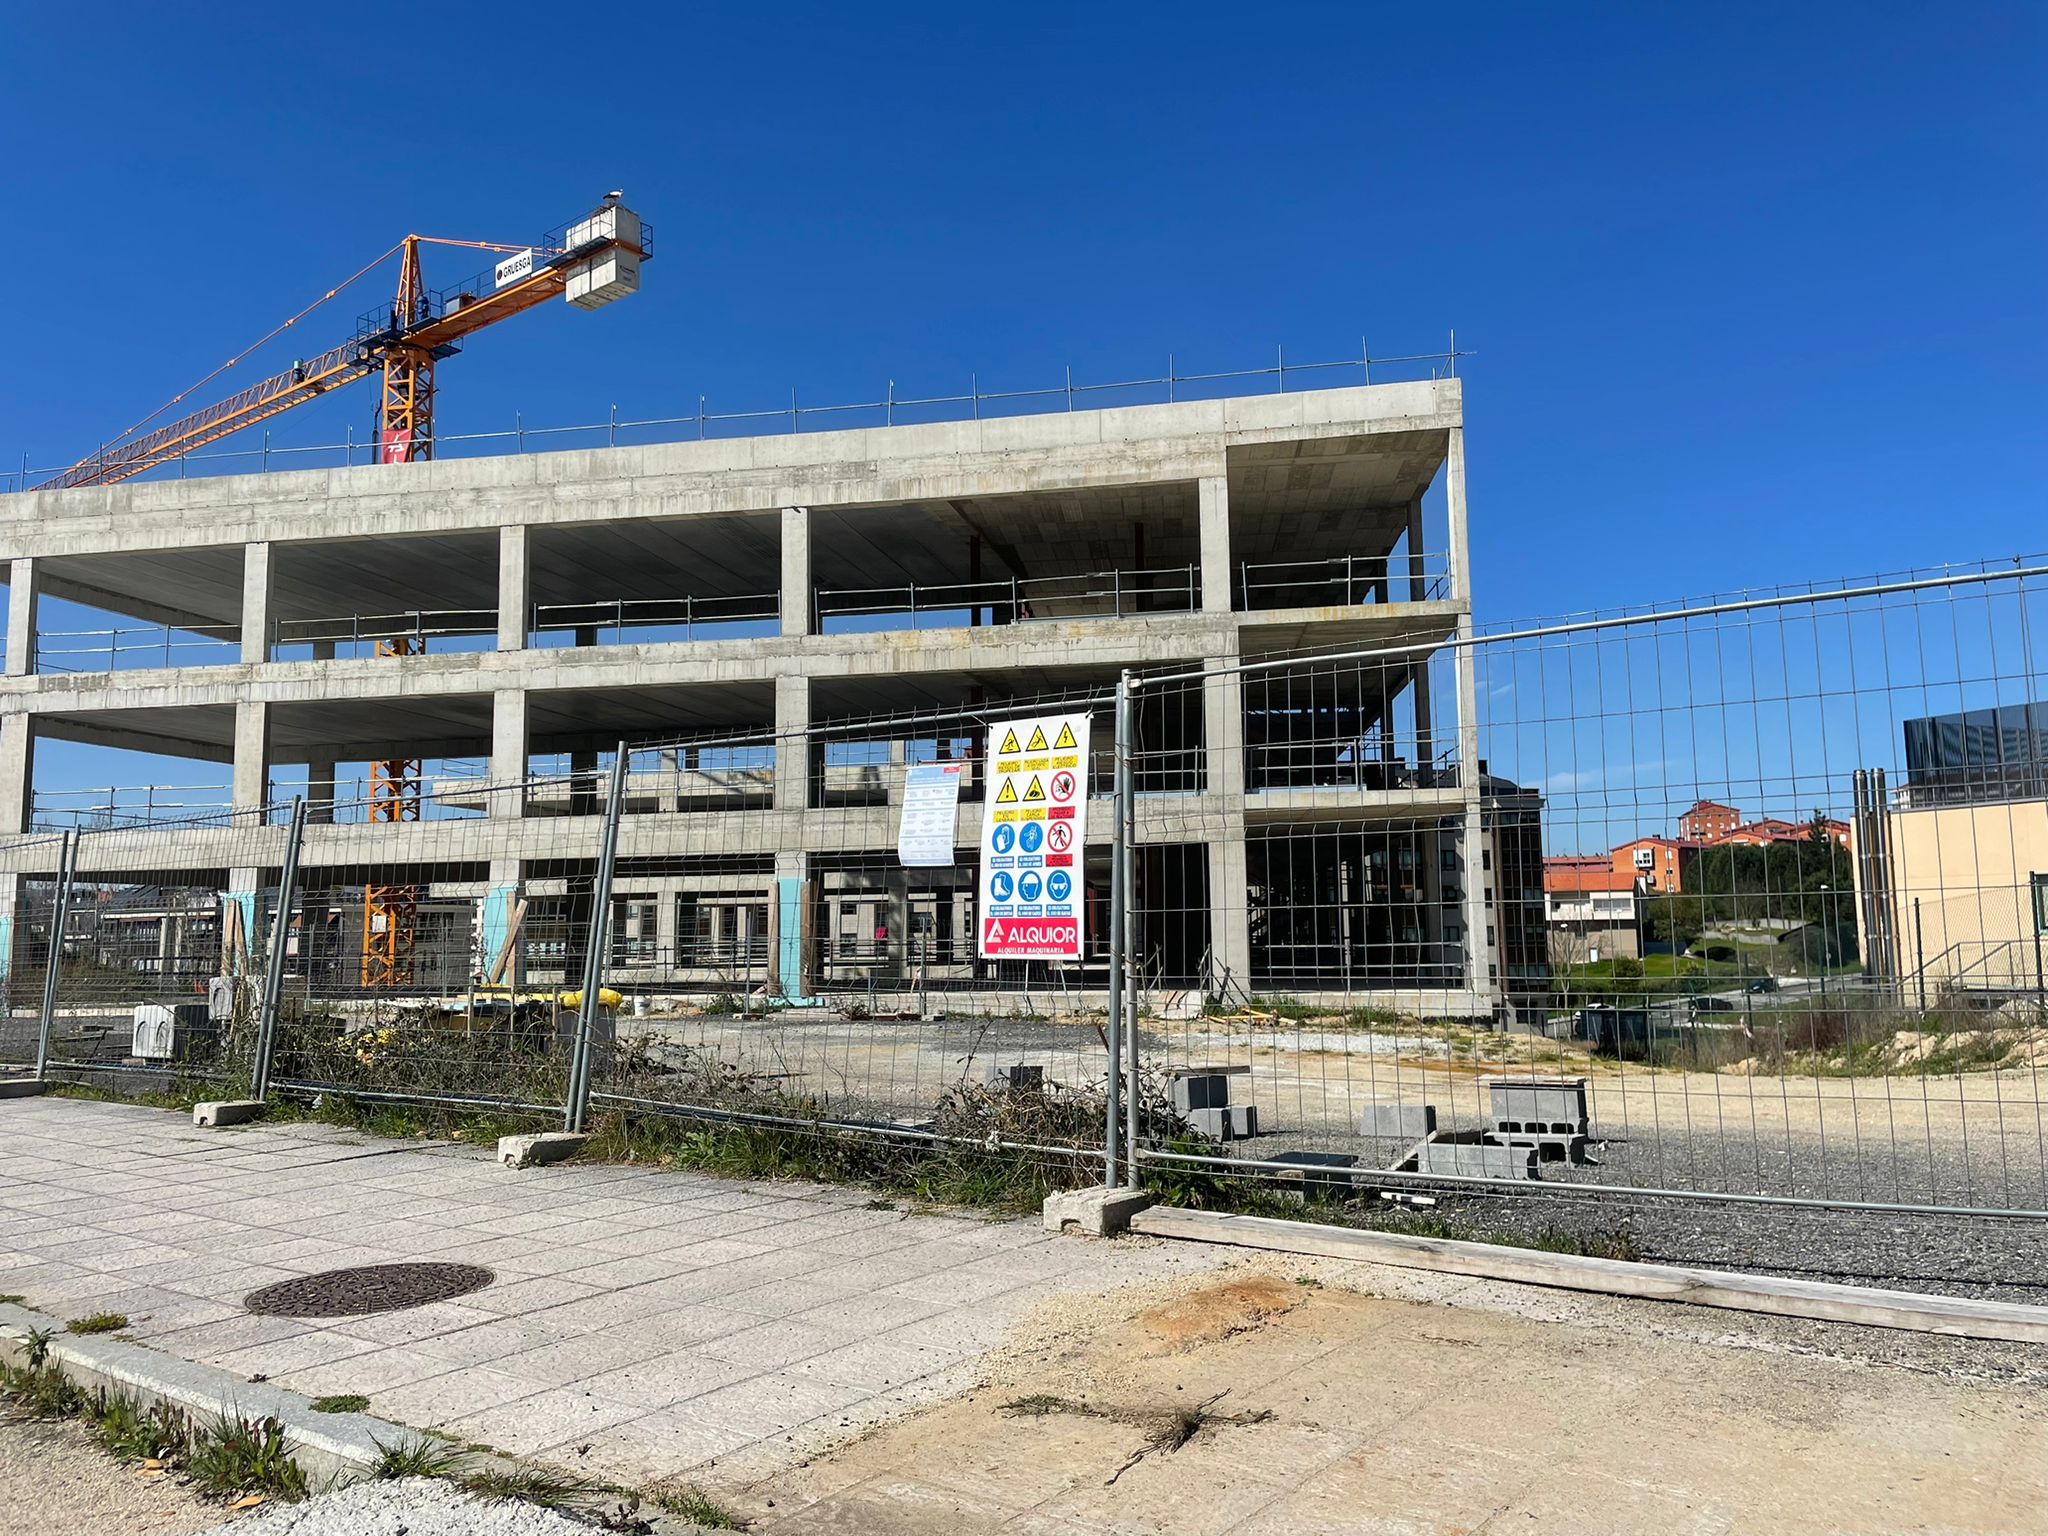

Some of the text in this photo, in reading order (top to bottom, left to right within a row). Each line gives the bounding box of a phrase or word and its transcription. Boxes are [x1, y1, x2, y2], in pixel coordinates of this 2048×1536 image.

[503, 255, 531, 278] GRUESGA
[1007, 926, 1076, 944] ALQUIOR
[997, 947, 1064, 955] ALQUILER MAQUINARIA
